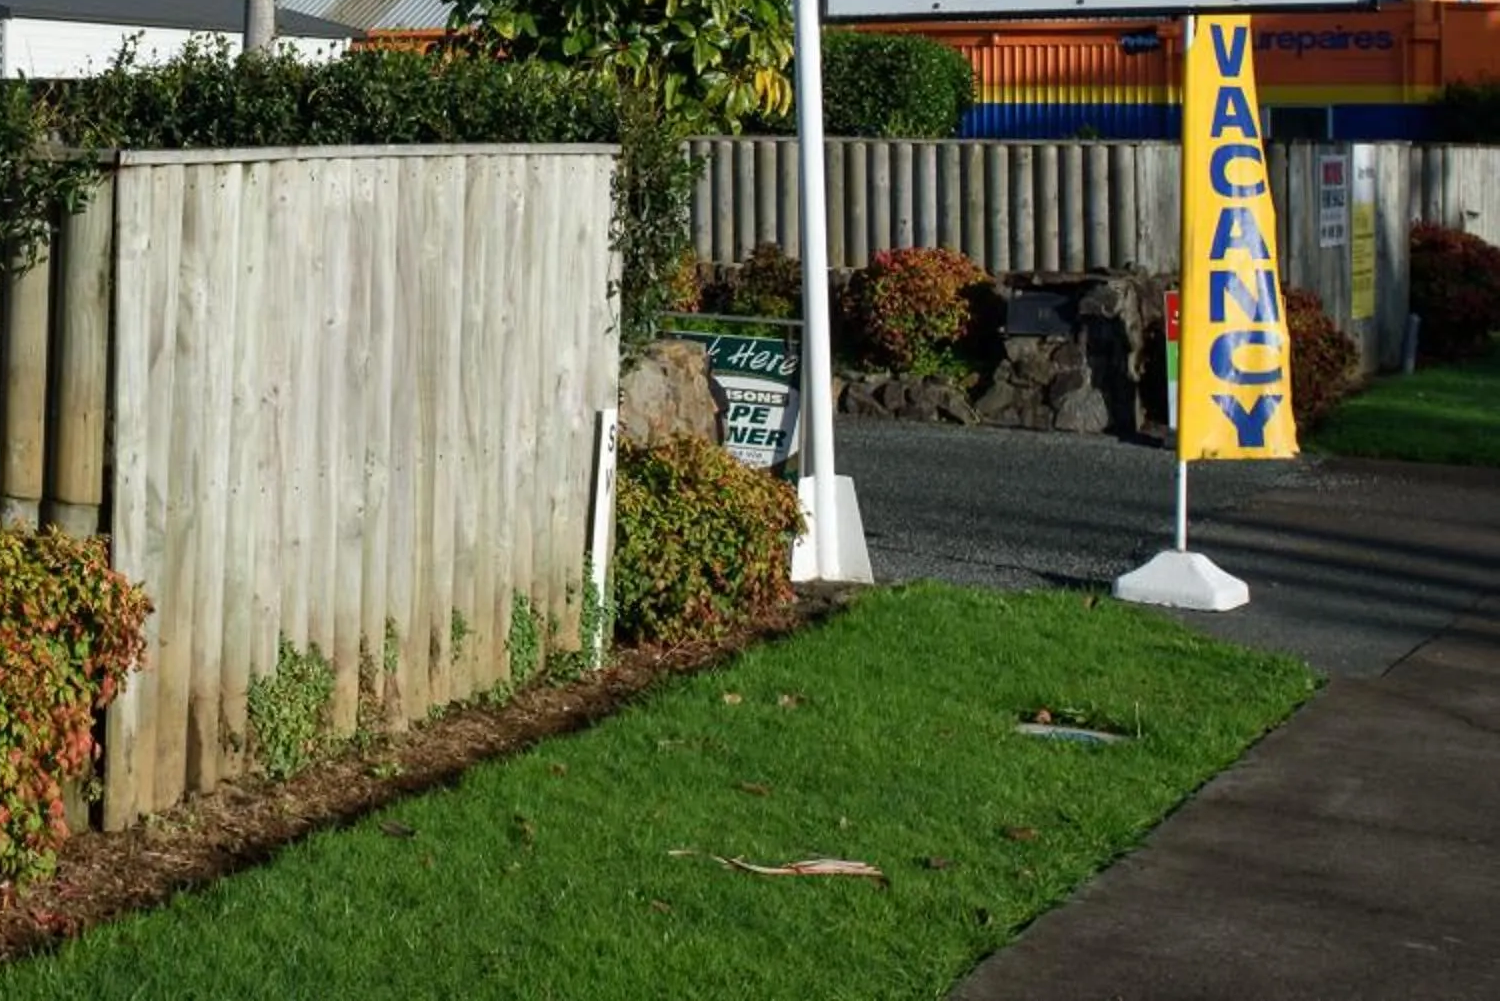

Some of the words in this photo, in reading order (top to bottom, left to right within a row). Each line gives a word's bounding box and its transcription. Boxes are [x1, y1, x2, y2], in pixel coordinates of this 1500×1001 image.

[1208, 24, 1284, 448] VACANCY
[727, 339, 799, 376] Here
[726, 426, 787, 448] NER
